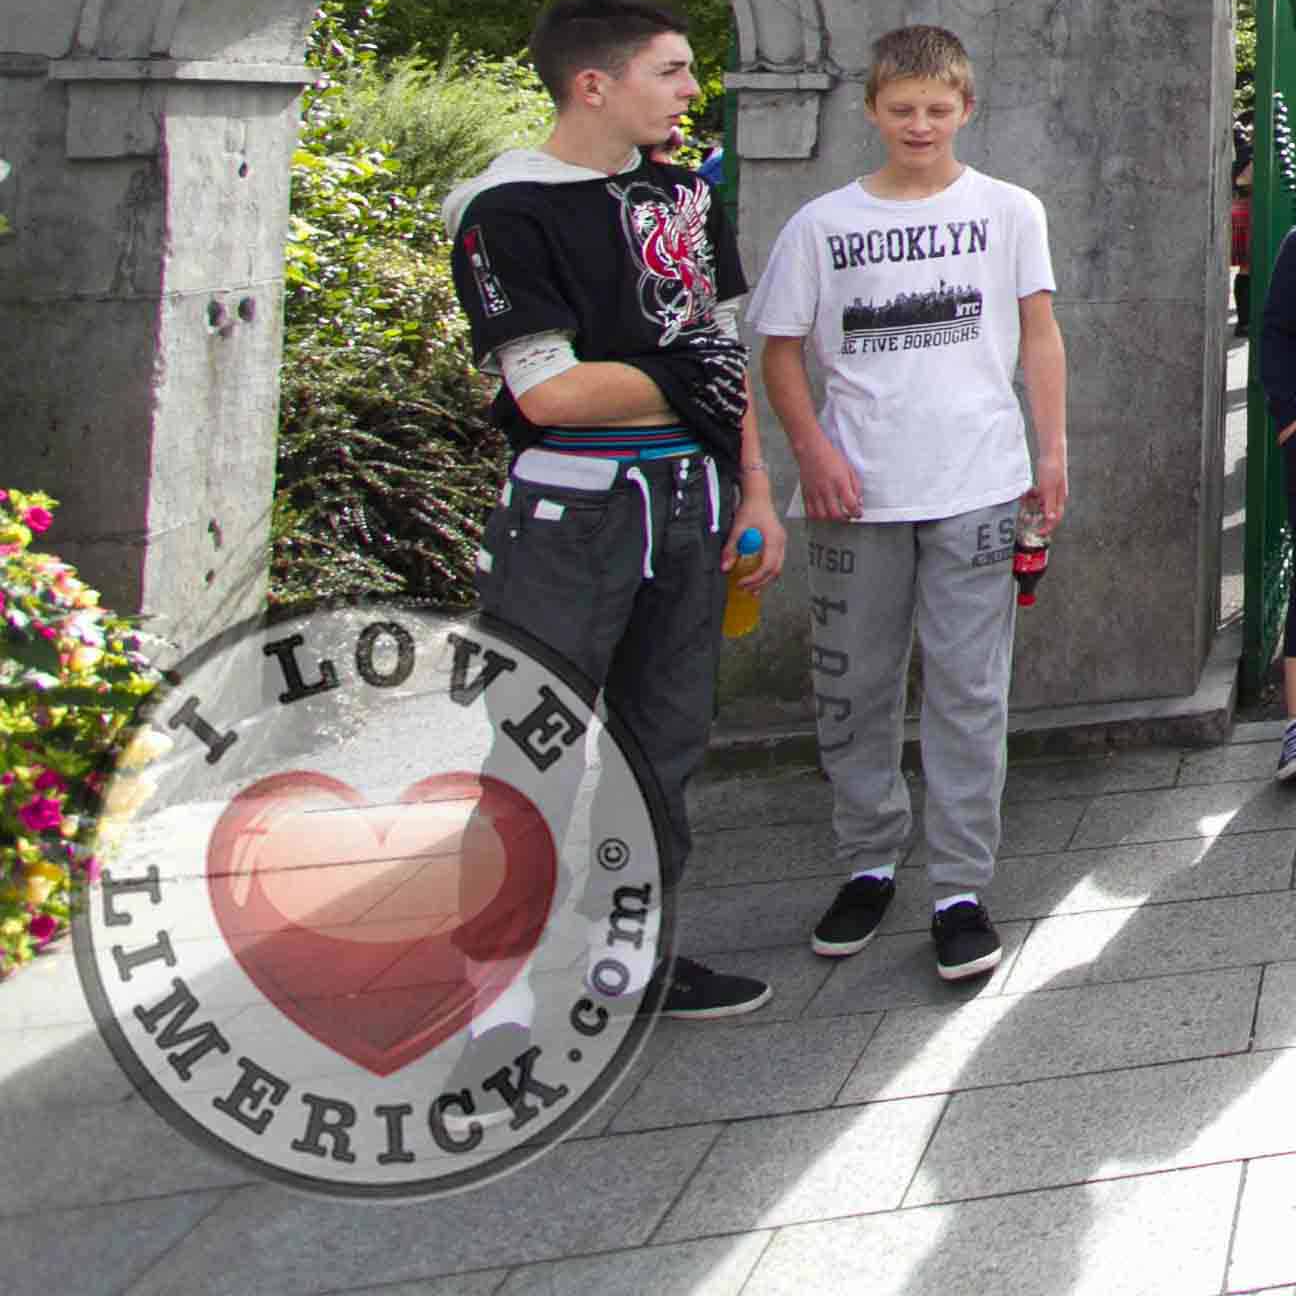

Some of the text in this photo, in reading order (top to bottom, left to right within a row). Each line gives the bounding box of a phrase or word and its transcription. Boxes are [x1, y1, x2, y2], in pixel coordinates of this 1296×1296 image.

[826, 217, 990, 271] BROOKLYN
[861, 336, 899, 353] FIVE
[903, 326, 980, 350] BOROUGHS
